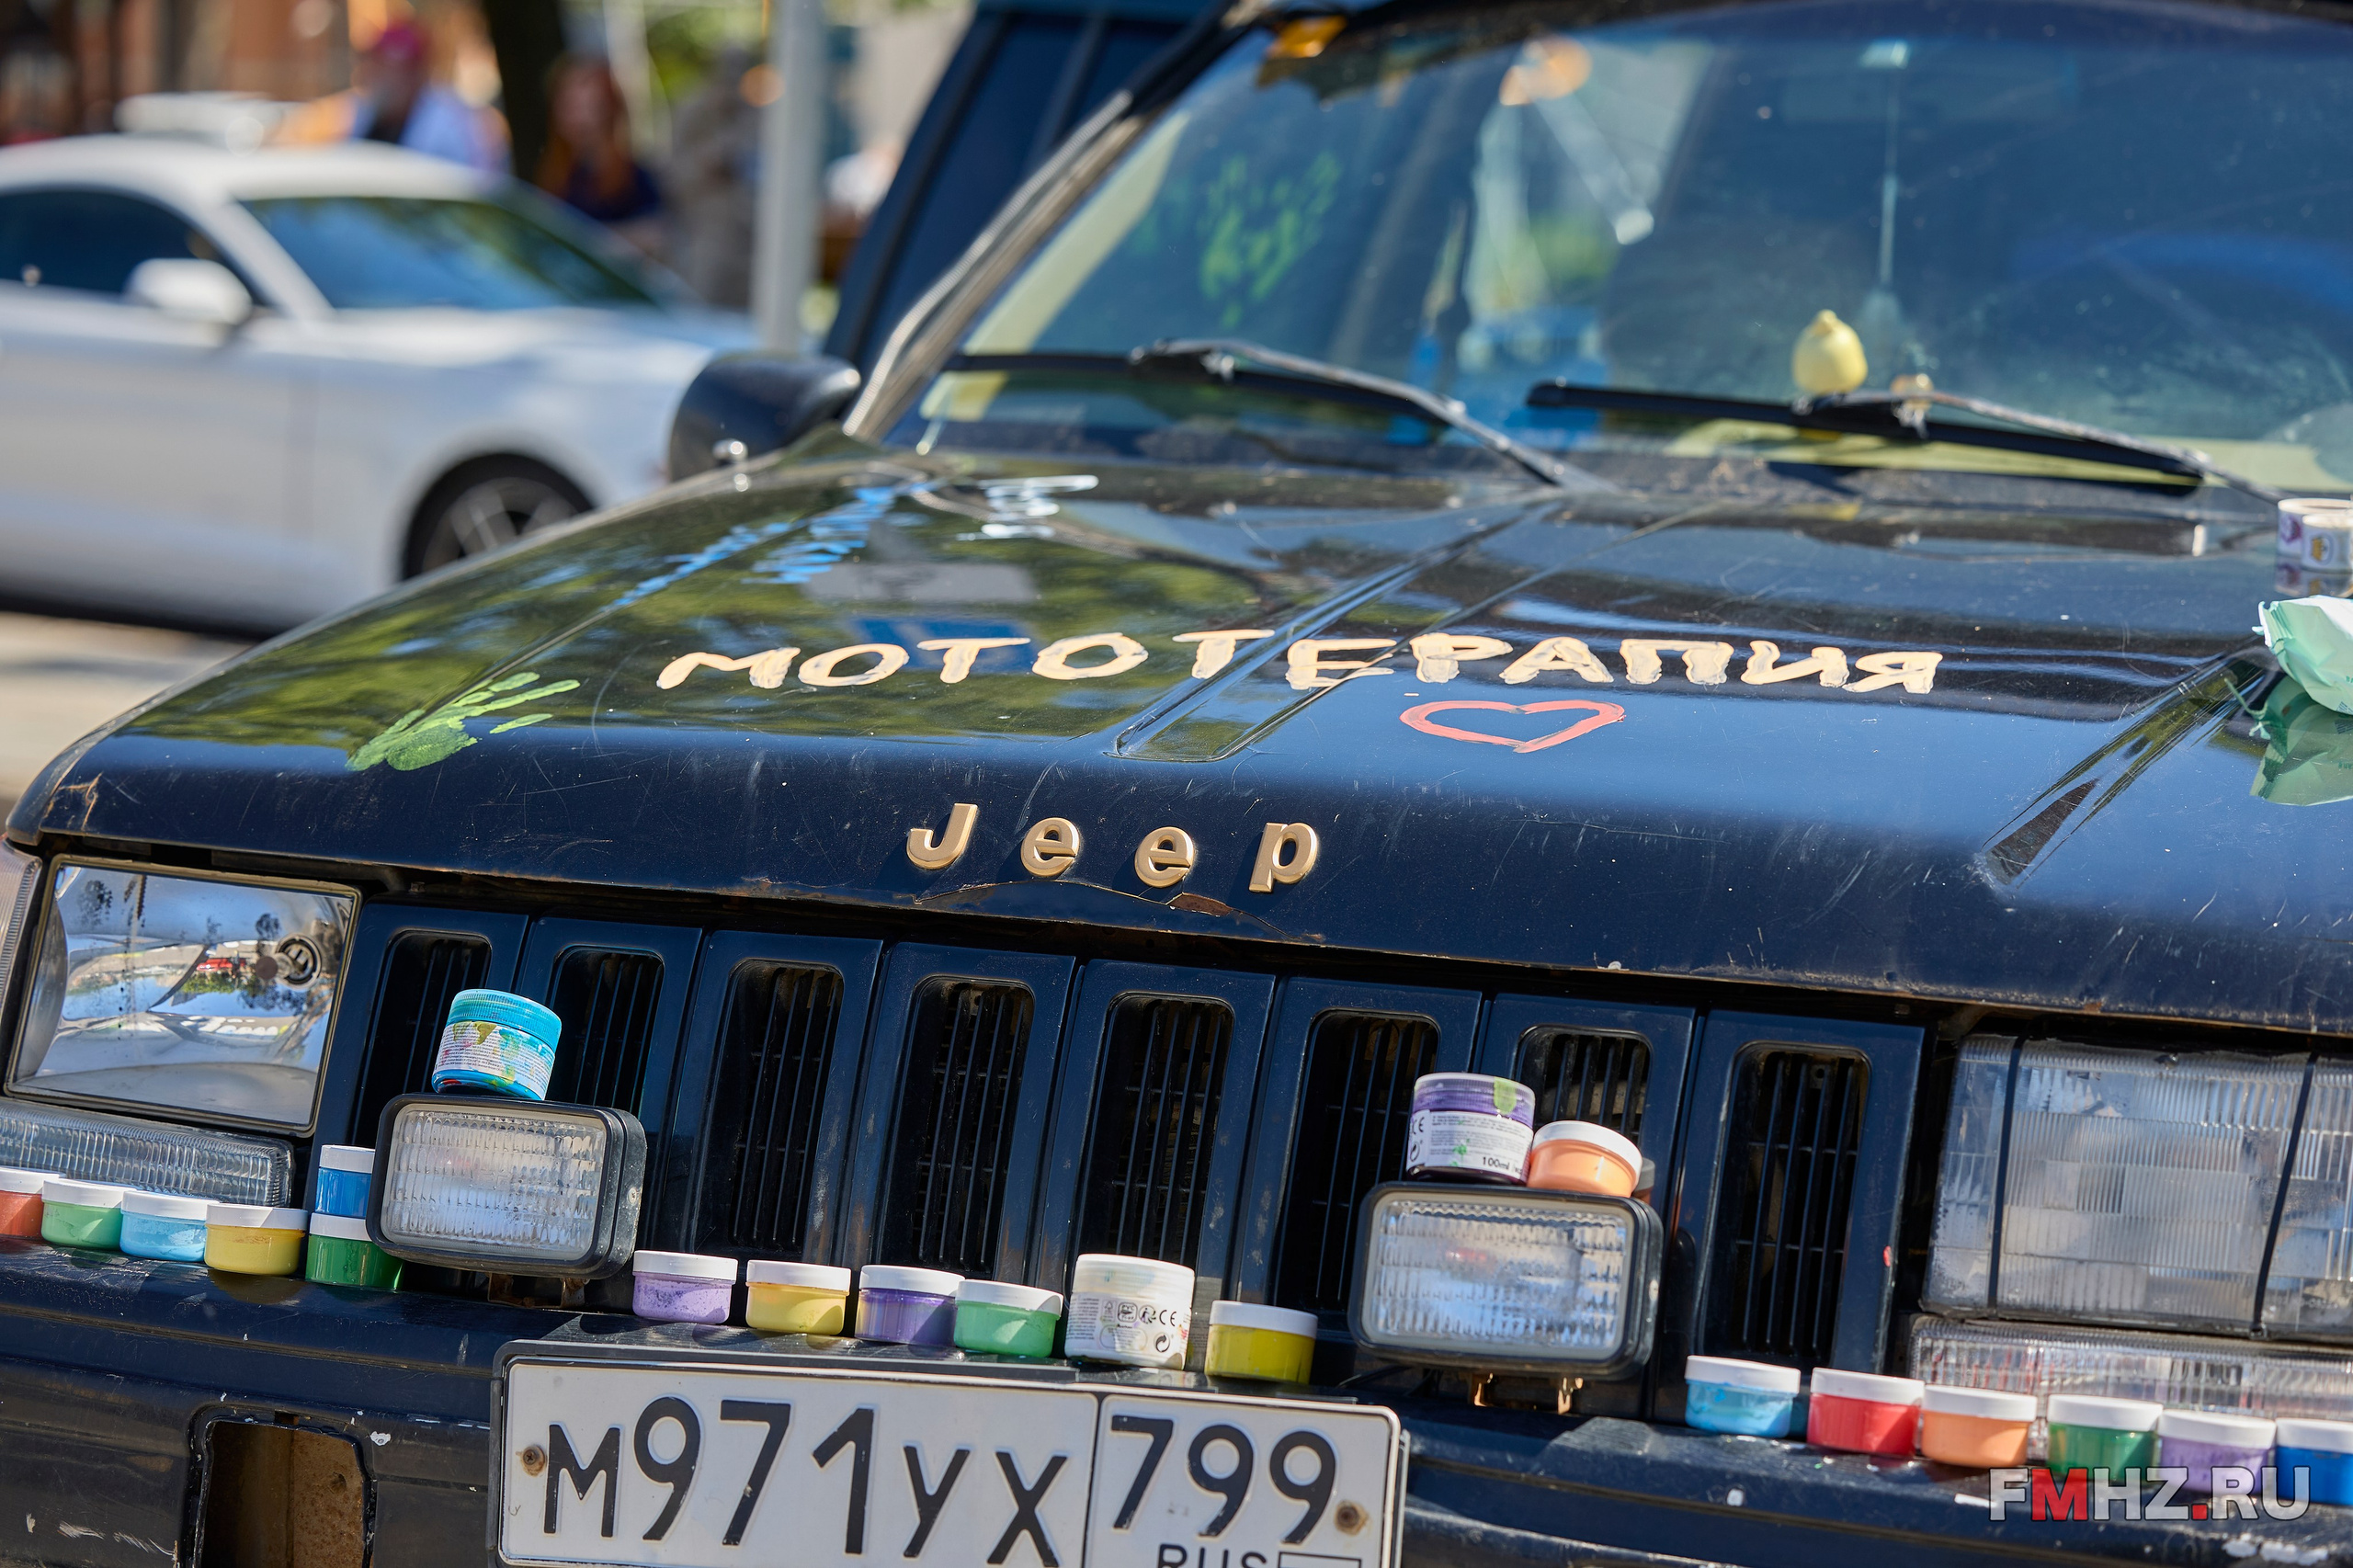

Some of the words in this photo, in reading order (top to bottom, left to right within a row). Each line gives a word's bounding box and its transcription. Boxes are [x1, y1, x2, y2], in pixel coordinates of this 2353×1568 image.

[656, 629, 1943, 696] МОТОТЕРАПИЯ
[906, 802, 1319, 893] Jeep
[1483, 1156, 1510, 1170] 100ml
[544, 1396, 1068, 1568] М971УХ
[1111, 1415, 1336, 1544] 799
